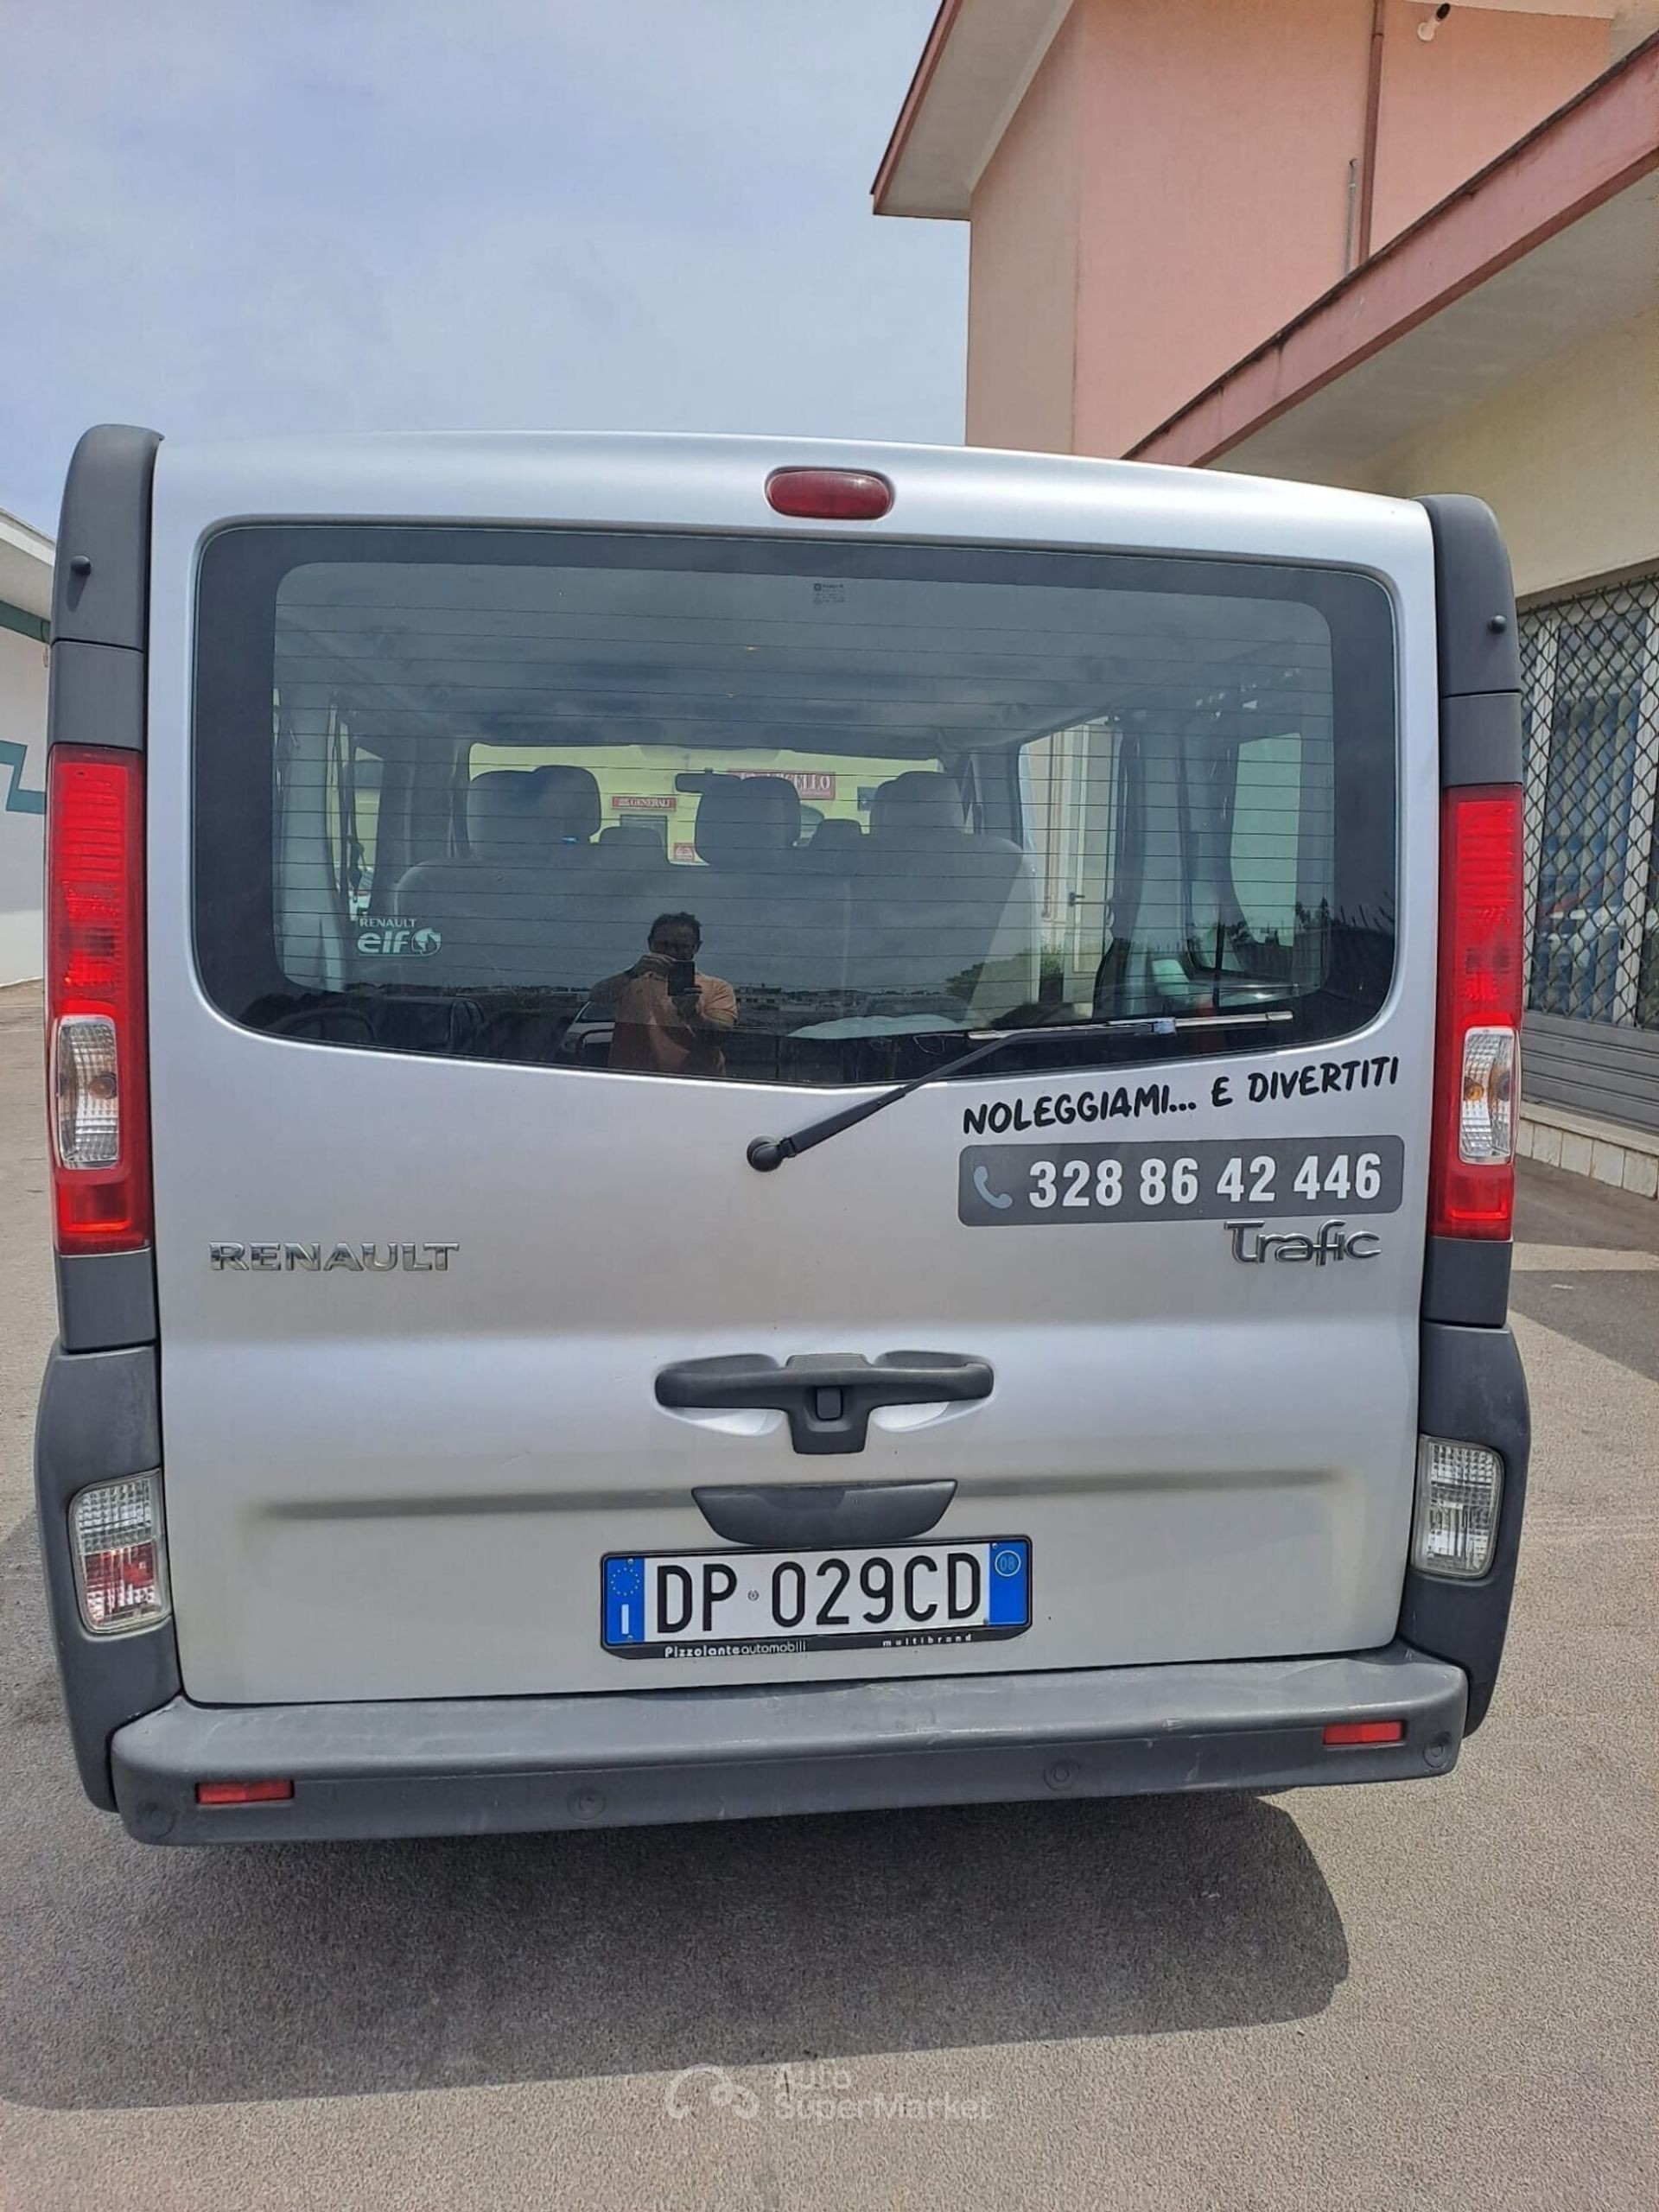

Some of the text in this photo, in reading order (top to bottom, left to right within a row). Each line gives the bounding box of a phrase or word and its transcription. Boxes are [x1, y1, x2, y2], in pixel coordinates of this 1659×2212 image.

[359, 918, 417, 928] RENAULT
[357, 931, 410, 954] elf
[963, 1057, 1400, 1135] NOLEGGIAMI... E DIVERTITI
[1028, 1153, 1382, 1209] 328 86 42 446
[208, 1240, 460, 1272] RENAULT
[1224, 1219, 1382, 1267] Trafic
[1000, 1555, 1016, 1572] 08
[657, 1563, 738, 1634] DP
[771, 1553, 982, 1628] 029CD
[882, 1633, 972, 1648] multibrand
